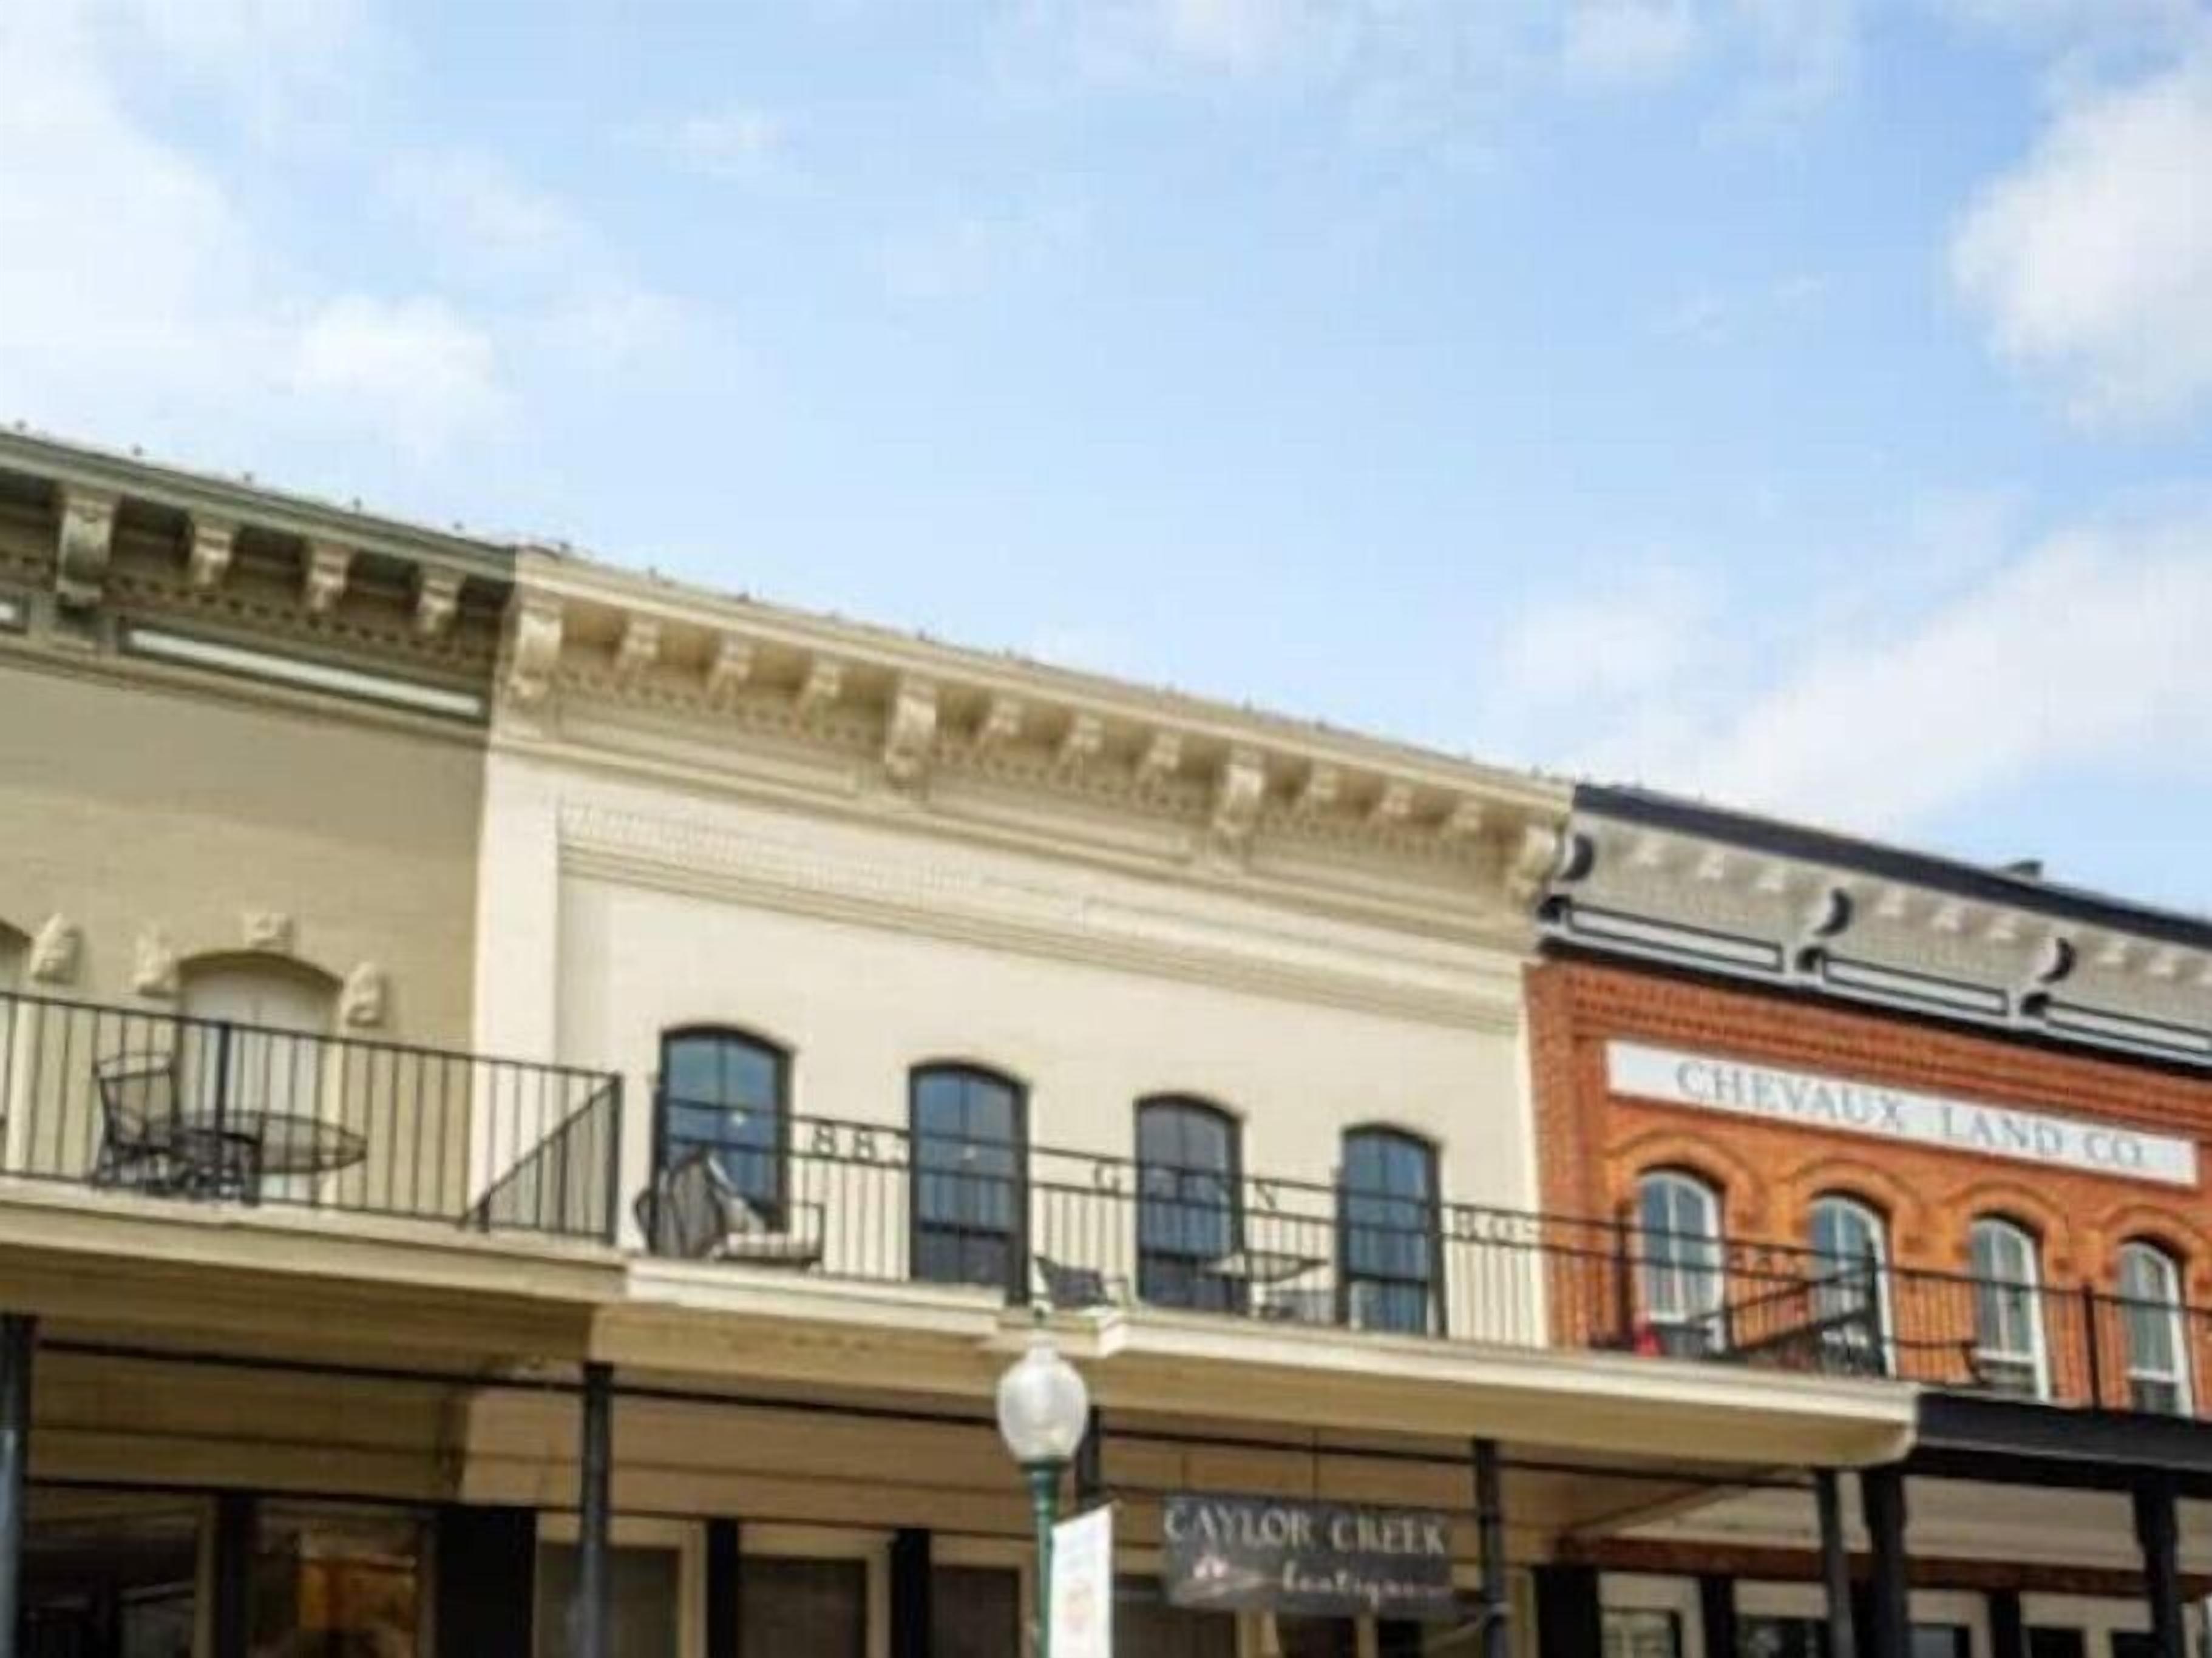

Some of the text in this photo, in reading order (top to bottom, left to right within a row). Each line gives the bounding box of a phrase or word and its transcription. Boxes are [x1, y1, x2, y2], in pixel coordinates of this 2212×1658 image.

[1676, 1061, 1905, 1134] CHEVAUX
[1942, 1106, 2063, 1154] LAND
[1332, 1514, 1445, 1555] CREEK
